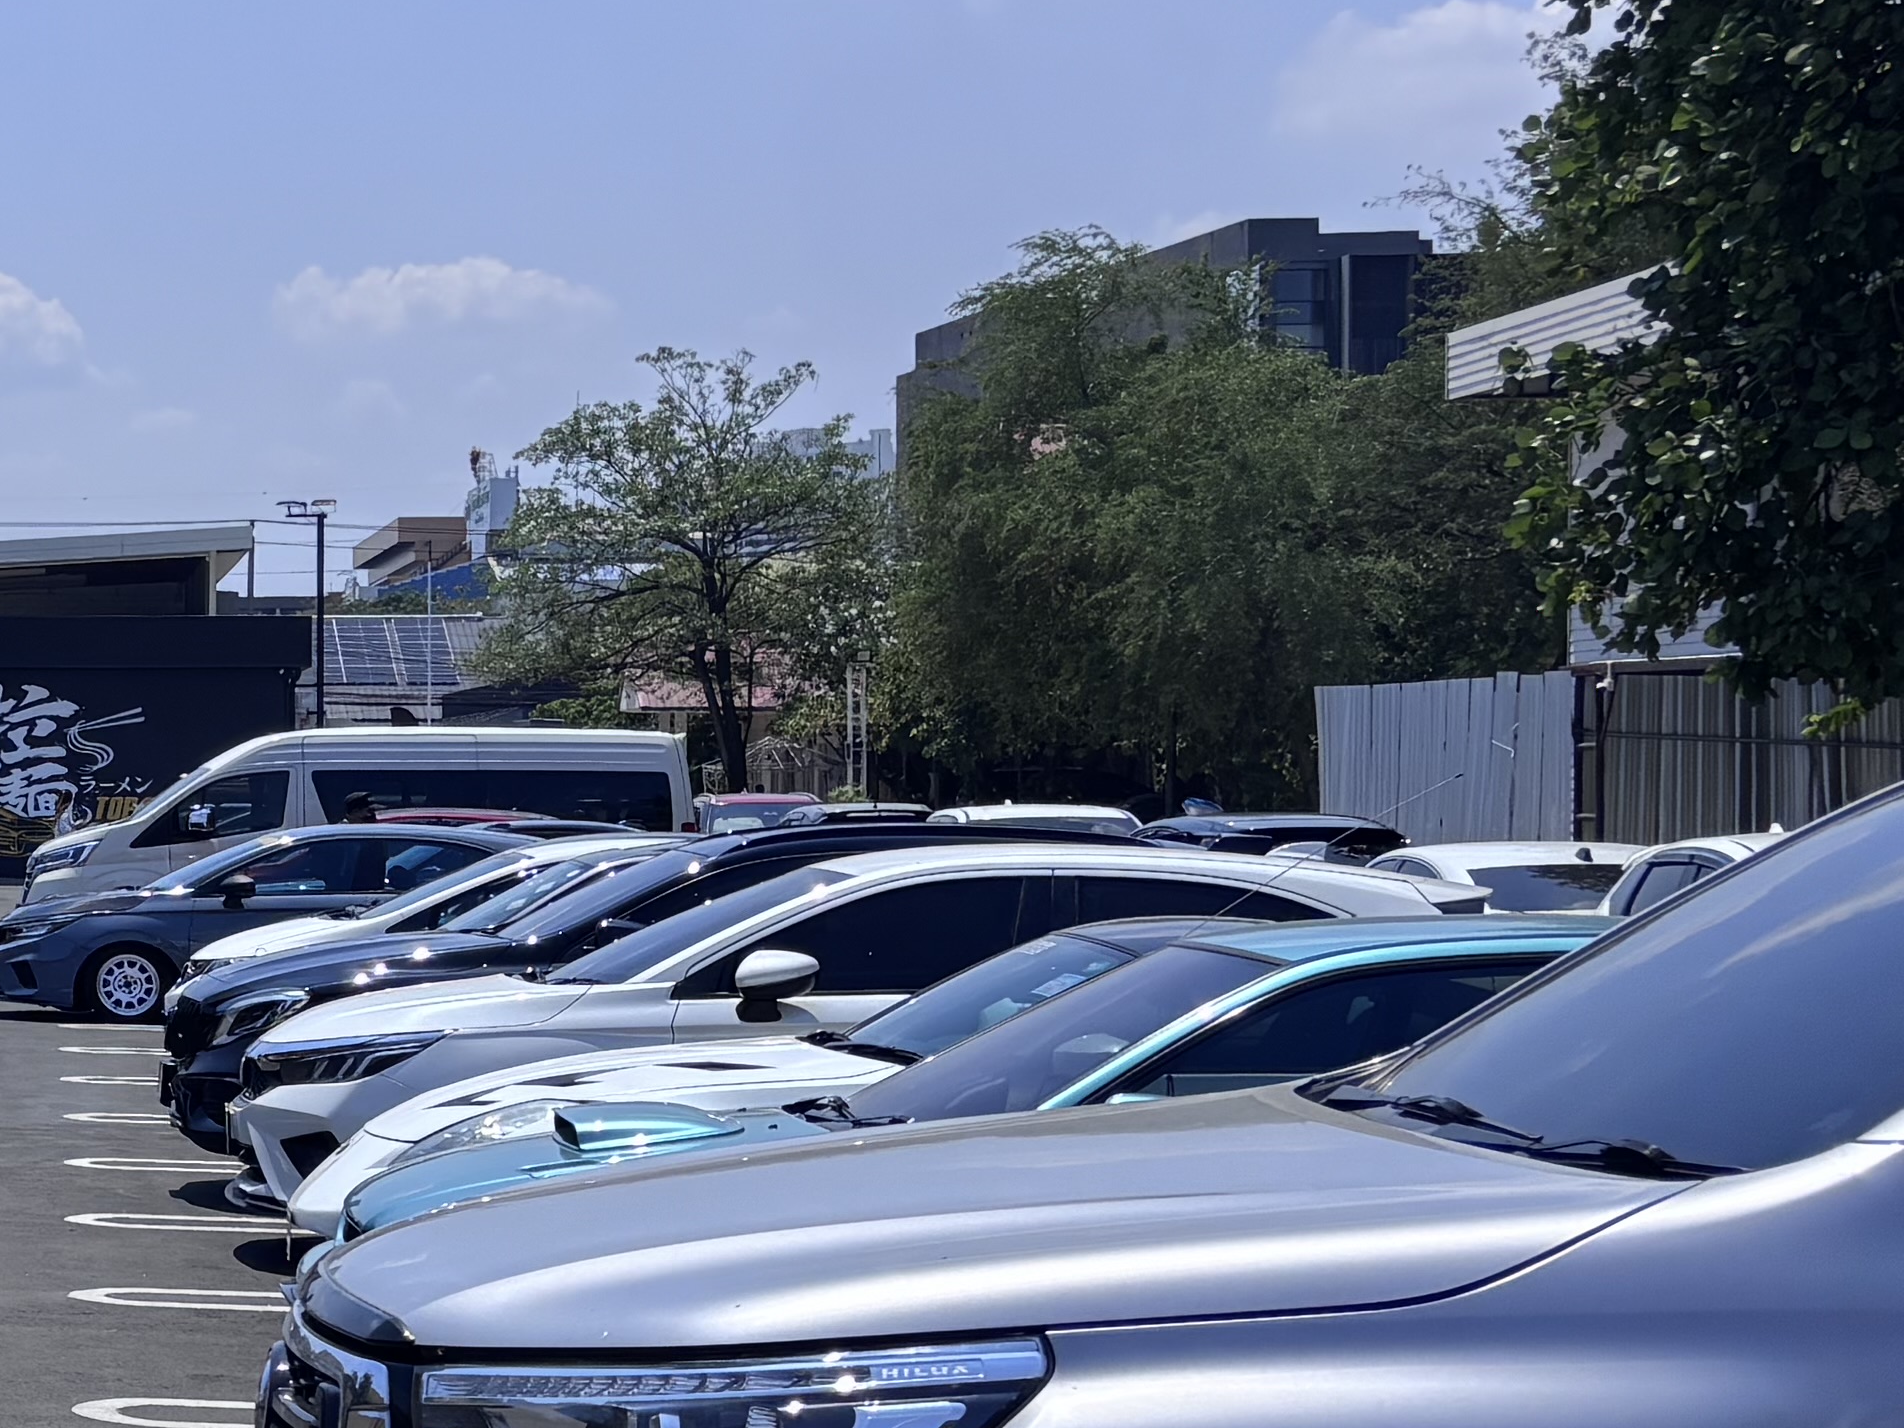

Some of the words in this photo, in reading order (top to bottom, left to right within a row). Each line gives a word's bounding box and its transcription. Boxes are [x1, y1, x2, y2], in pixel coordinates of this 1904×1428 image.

[79, 775, 154, 794] ラーメン
[881, 1365, 969, 1379] HILUX
